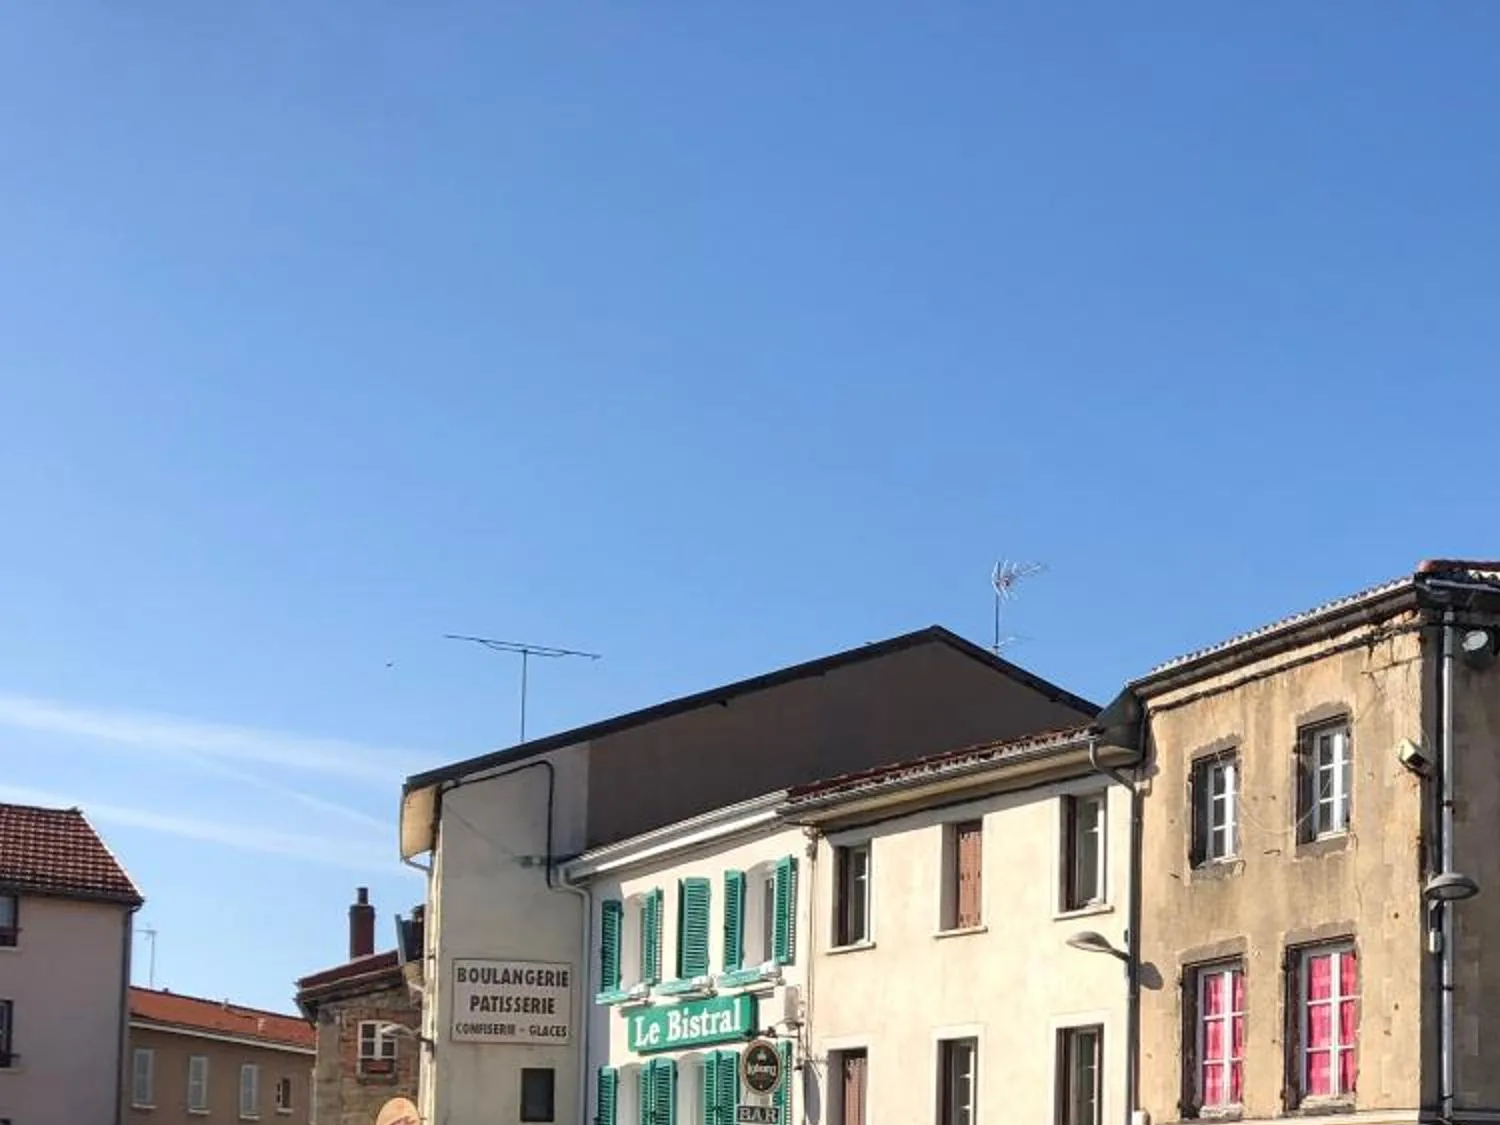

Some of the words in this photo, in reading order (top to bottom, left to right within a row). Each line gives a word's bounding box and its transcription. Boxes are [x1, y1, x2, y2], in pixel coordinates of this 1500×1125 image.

[457, 967, 568, 988] BOULANGERIE
[470, 995, 555, 1014] PATISSERIE
[529, 1025, 567, 1037] GLACES
[634, 1015, 660, 1047] Le
[667, 999, 741, 1042] Bistral
[739, 1107, 777, 1122] BAR
